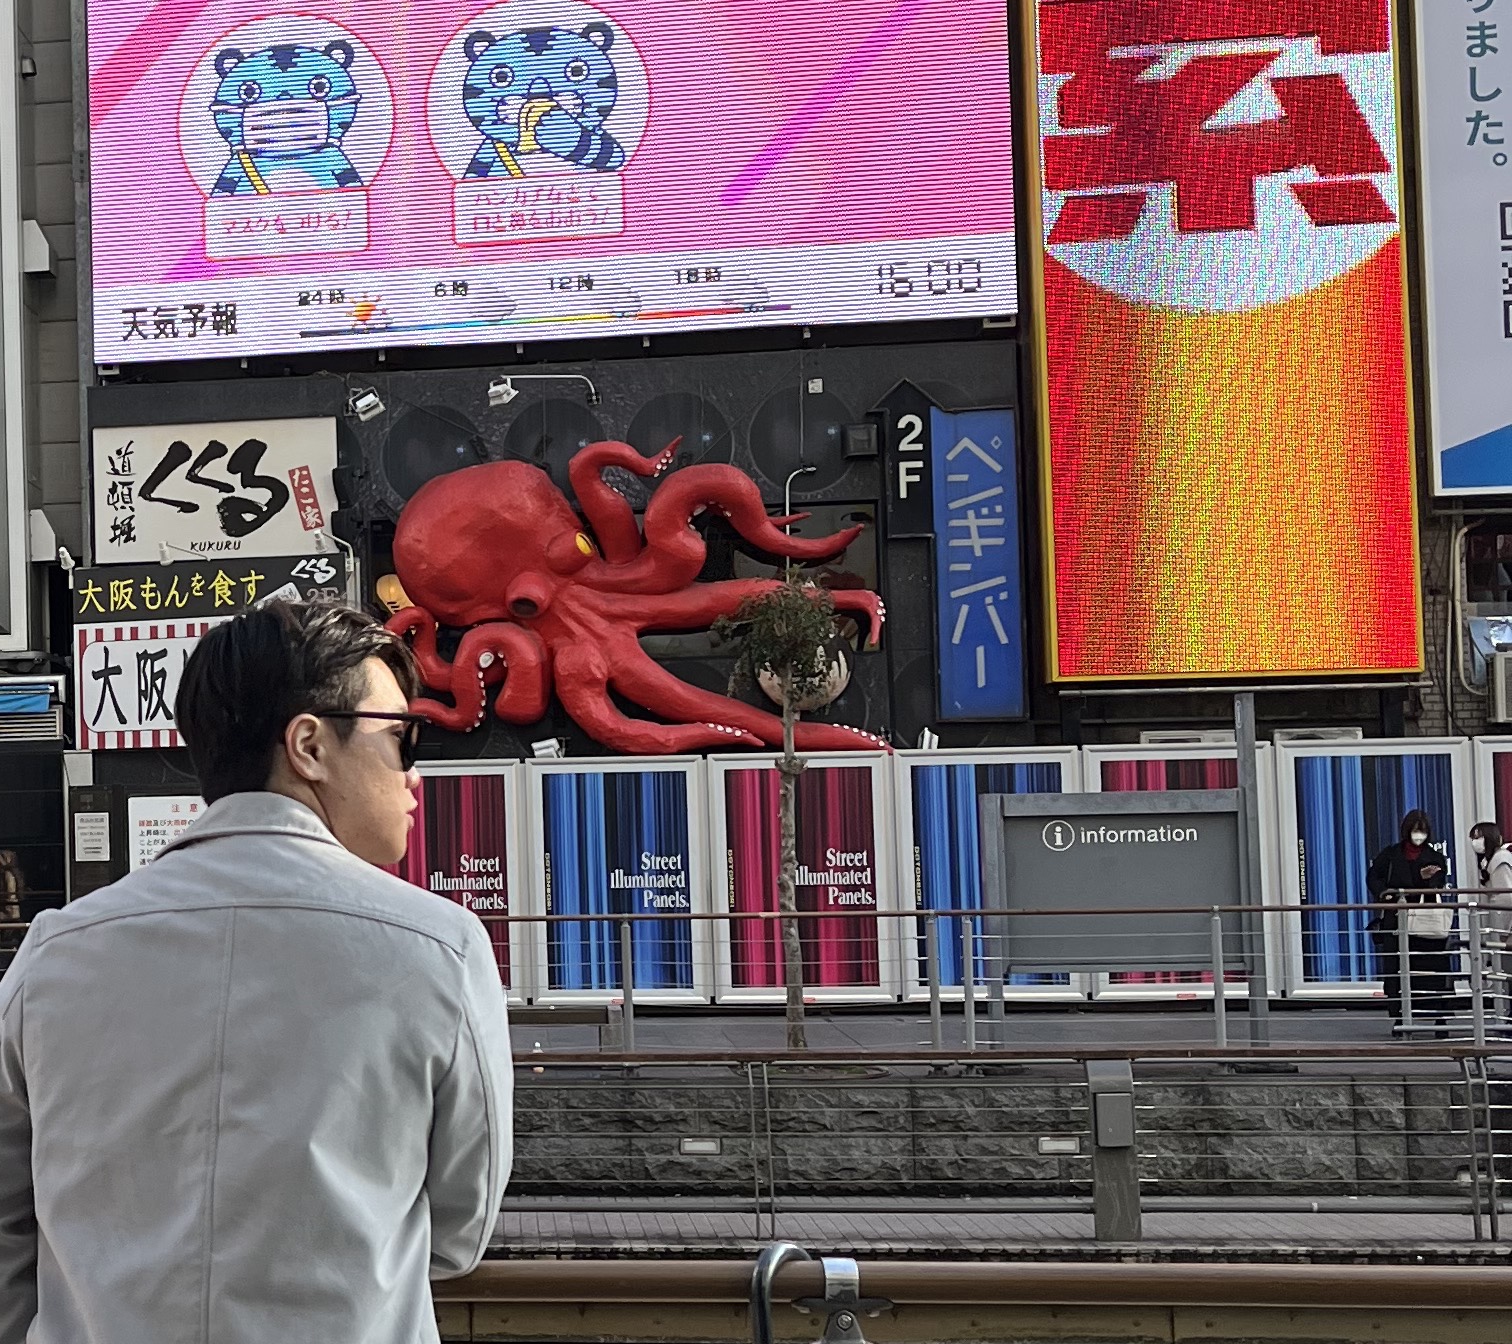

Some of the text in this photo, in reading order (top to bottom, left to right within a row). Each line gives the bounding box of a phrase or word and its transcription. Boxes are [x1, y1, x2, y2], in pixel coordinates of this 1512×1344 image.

[122, 302, 238, 342] 天気予報
[897, 414, 924, 499] 2F
[106, 440, 137, 546] 道頓堀
[138, 438, 289, 537] くくる
[190, 540, 242, 552] KUKURU
[290, 558, 337, 584] くくる
[946, 435, 1009, 689] ペンギンバー
[78, 569, 265, 614] 大阪もんを食す
[91, 646, 188, 726] 大阪
[1080, 824, 1198, 843] information
[460, 854, 500, 872] Street
[641, 851, 682, 870] Street
[826, 847, 868, 867] Street
[462, 892, 507, 910] Panels.
[643, 889, 689, 908] Panels.
[828, 886, 876, 905] Panels.
